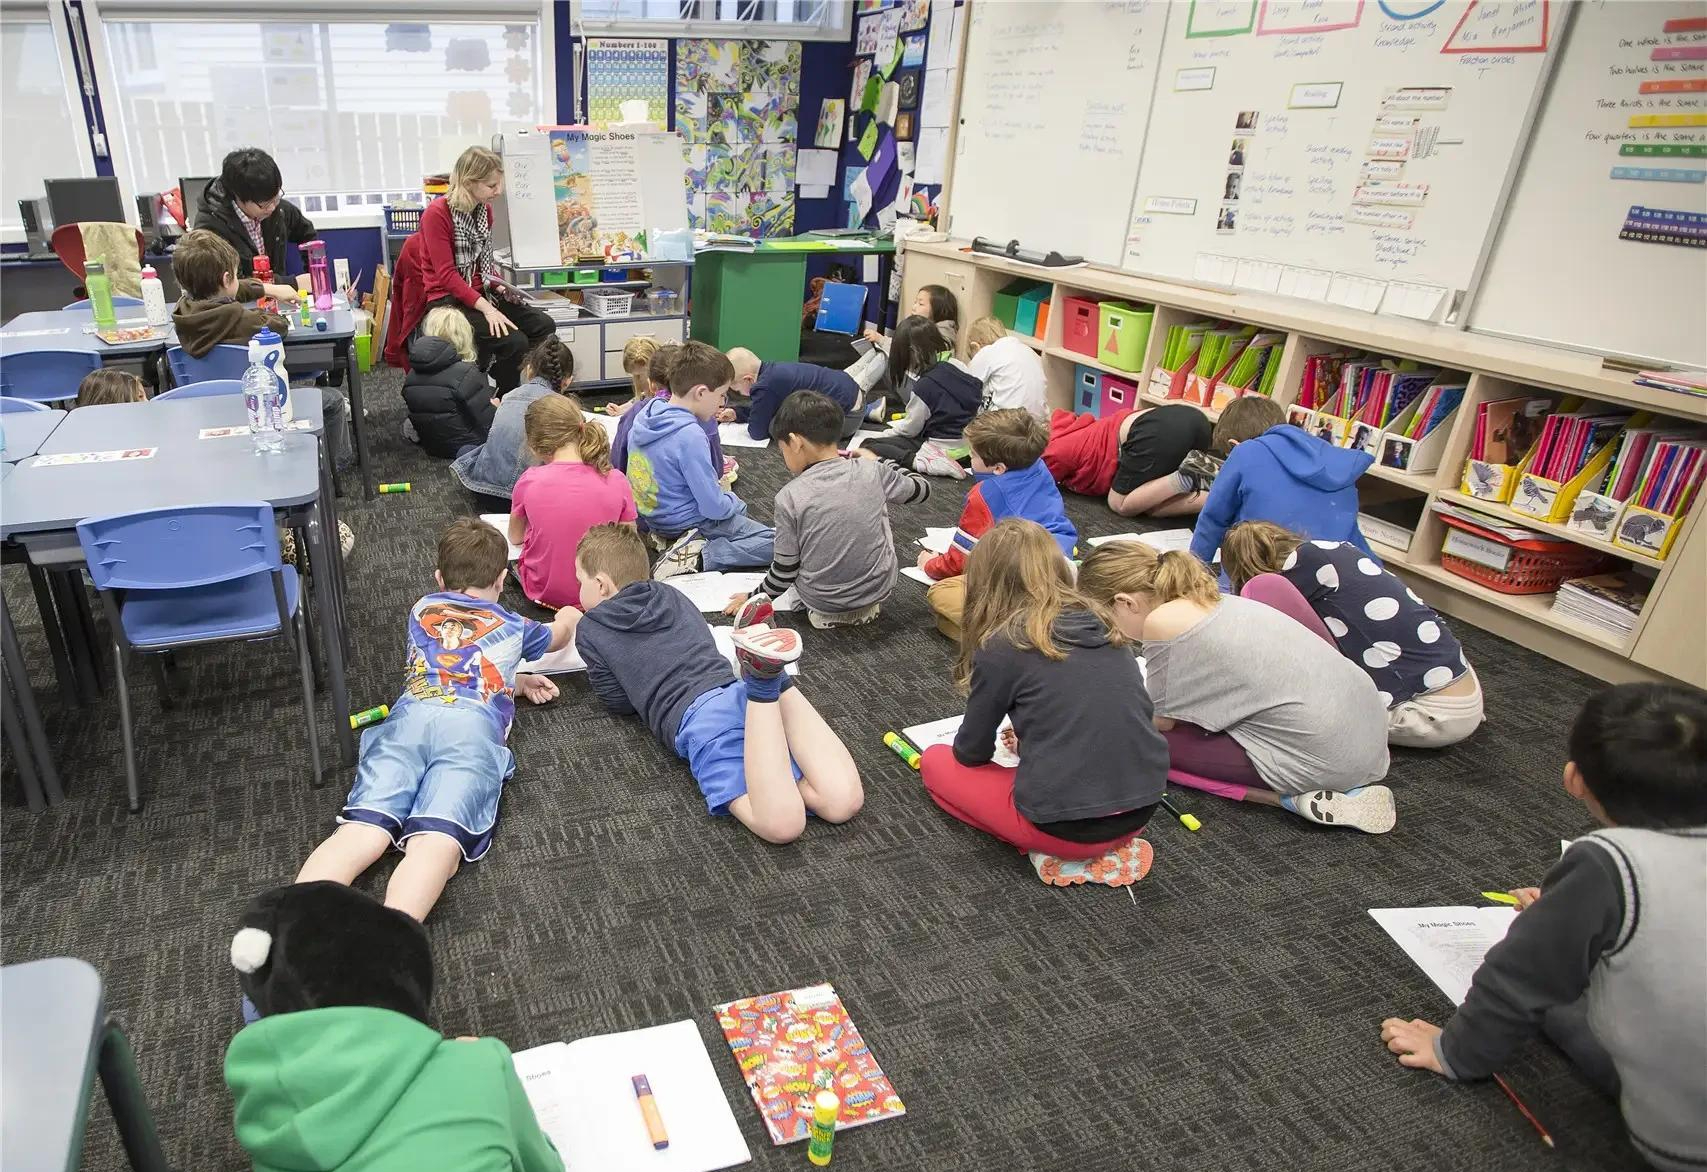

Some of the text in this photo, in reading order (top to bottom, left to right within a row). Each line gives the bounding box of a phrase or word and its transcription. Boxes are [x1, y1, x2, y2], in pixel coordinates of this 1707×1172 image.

[599, 41, 635, 49] Numbers
[567, 132, 636, 143] My Magic Shoes
